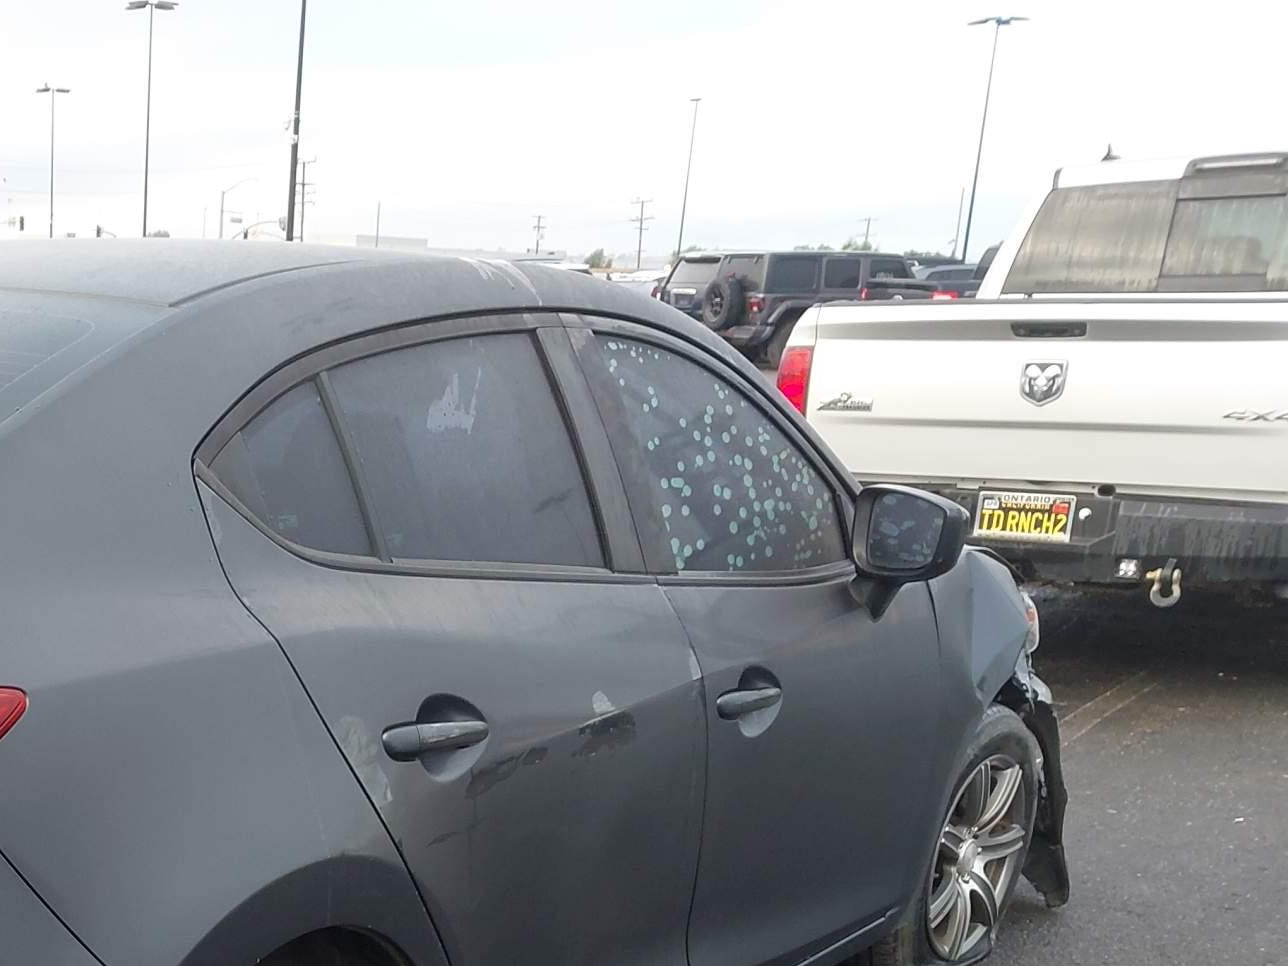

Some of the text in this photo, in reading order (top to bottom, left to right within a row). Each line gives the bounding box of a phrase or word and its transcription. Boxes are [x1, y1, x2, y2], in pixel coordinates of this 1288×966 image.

[1003, 494, 1051, 503] ONTARIO
[982, 508, 1067, 536] TD RNCH2
